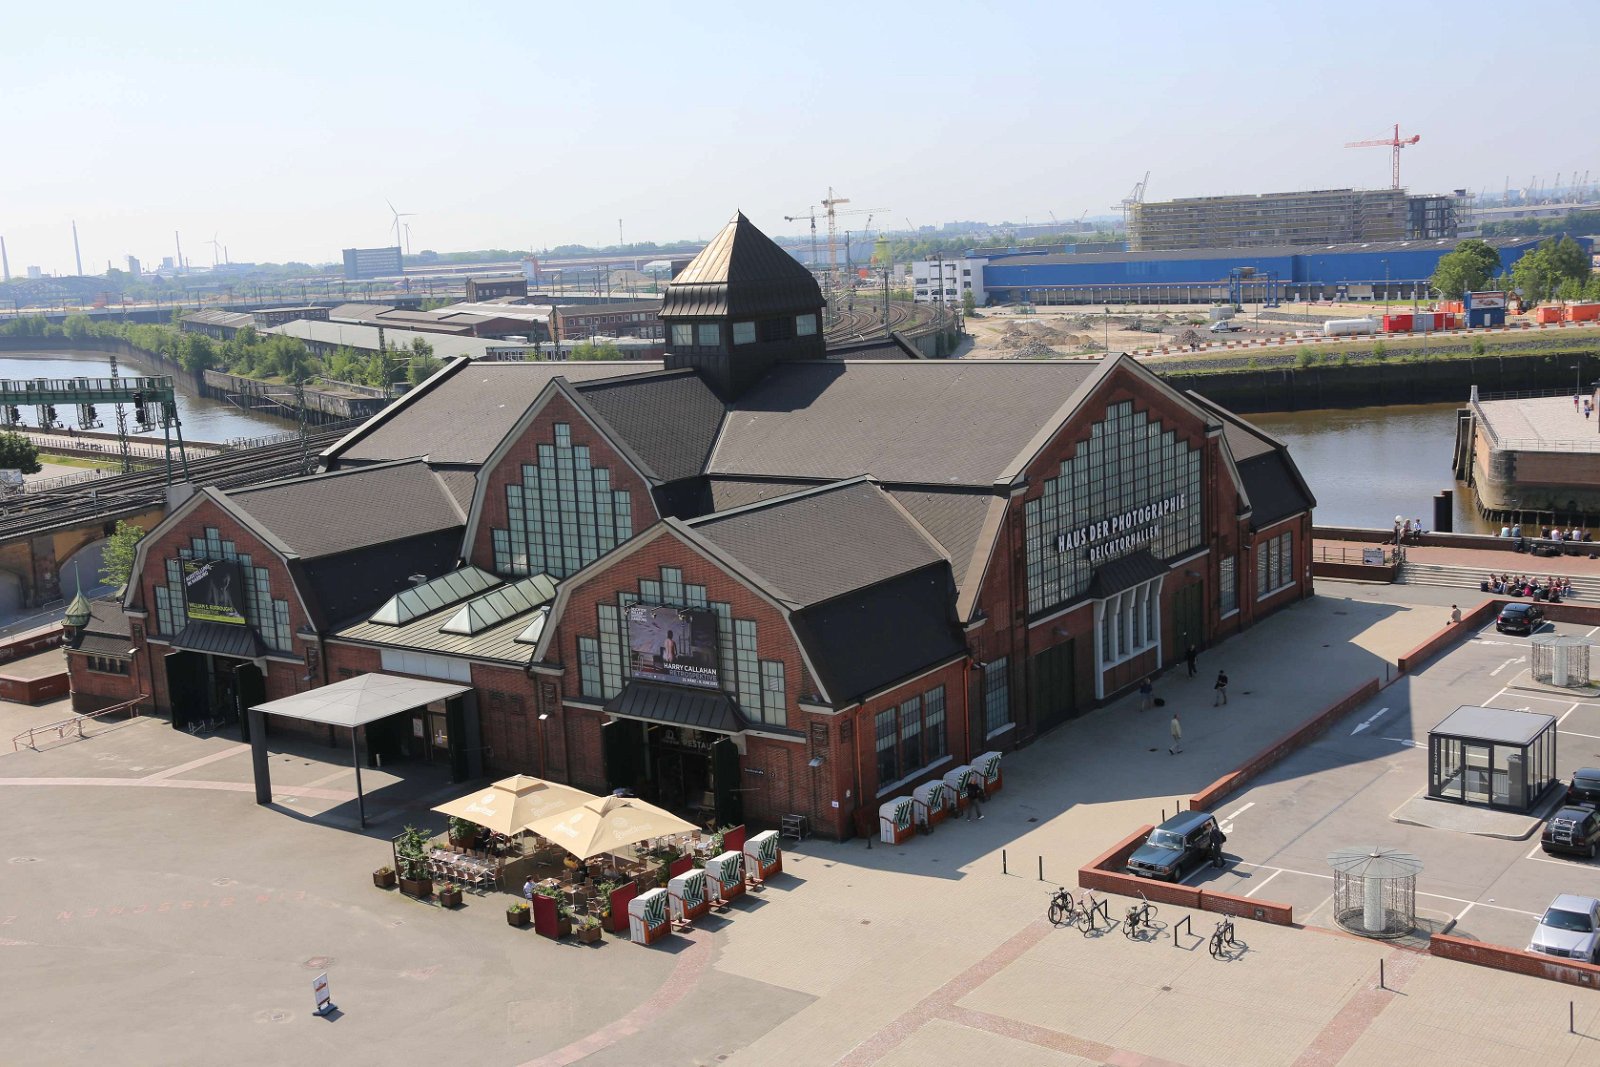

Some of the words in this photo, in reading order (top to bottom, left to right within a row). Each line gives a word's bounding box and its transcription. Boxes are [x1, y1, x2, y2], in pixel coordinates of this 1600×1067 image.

[1058, 528, 1086, 553] HAUS
[1089, 520, 1109, 541] DER
[1112, 494, 1185, 533] PHOTOGRAPHIE
[1090, 525, 1159, 561] DEICHTORHALLEN
[663, 662, 683, 671] HARRY
[684, 665, 717, 676] CALLAHAN
